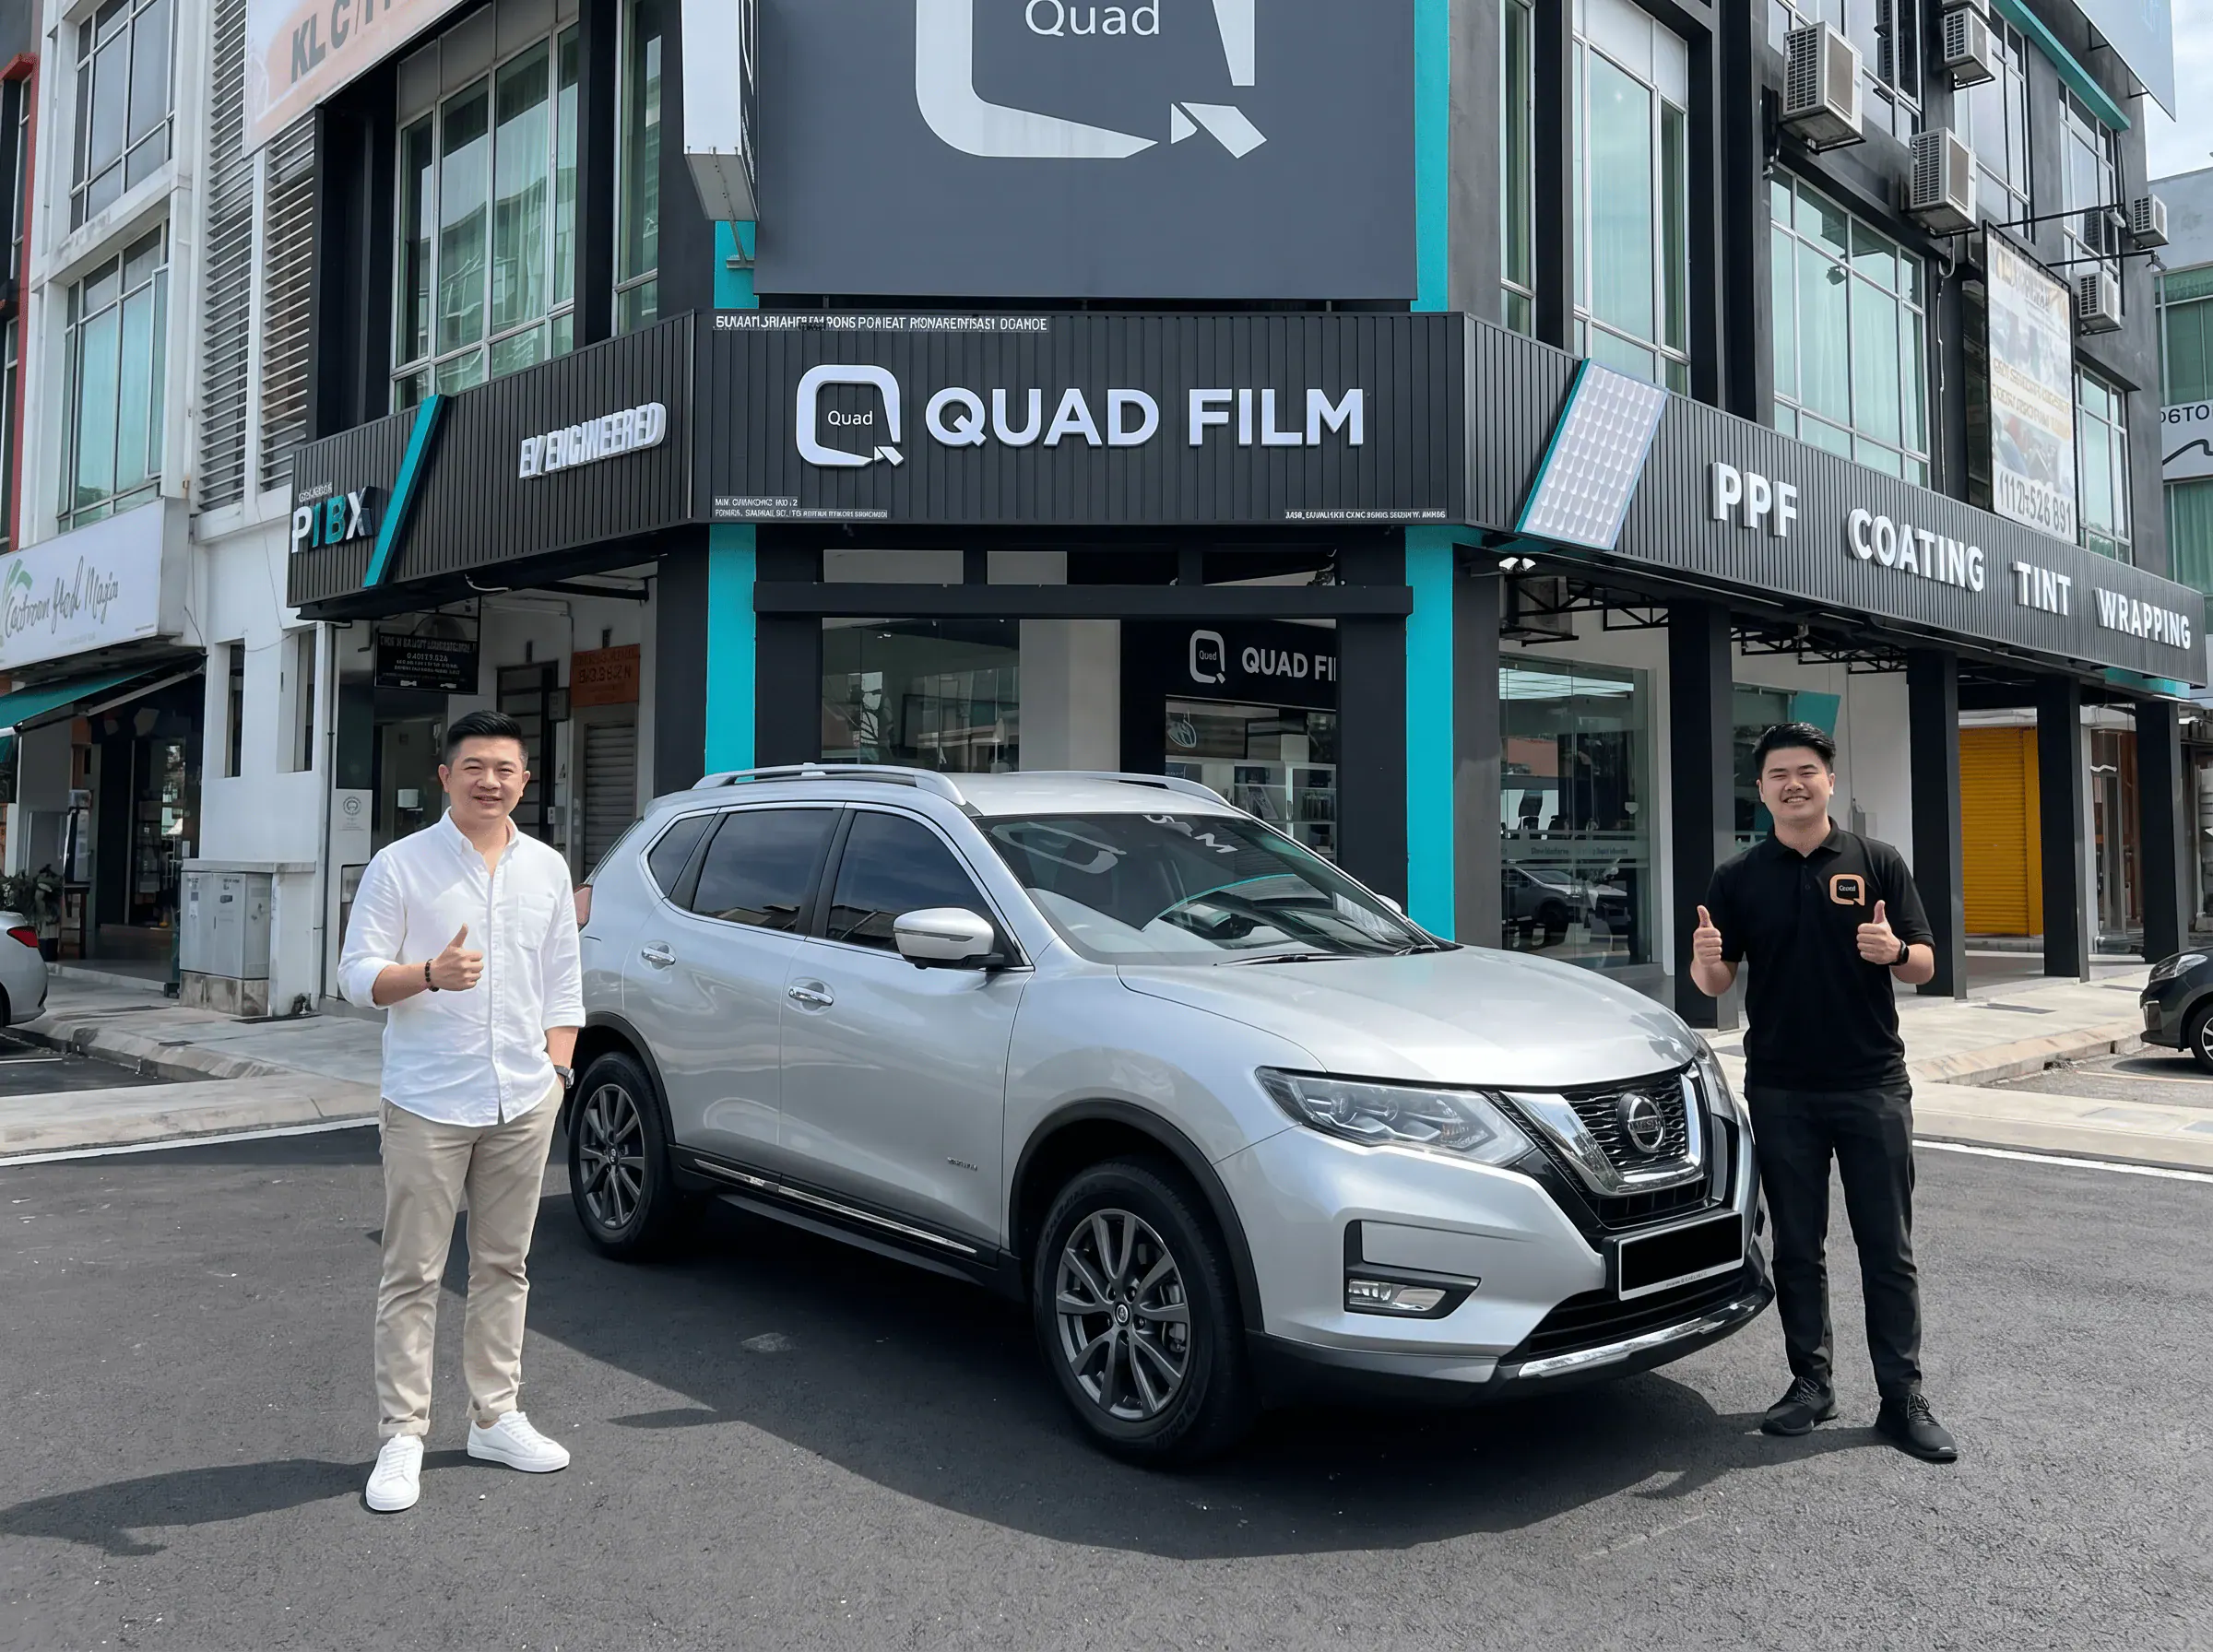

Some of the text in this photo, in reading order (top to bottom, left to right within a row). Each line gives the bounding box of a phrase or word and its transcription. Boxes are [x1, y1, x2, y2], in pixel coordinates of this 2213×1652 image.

[1025, 0, 1160, 37] Quad
[828, 410, 873, 426] Quad
[925, 387, 1365, 448] QUAD FILM
[1712, 462, 2191, 650] PPF COATING TINT WRAPPING
[1242, 647, 1336, 681] QUAD FI
